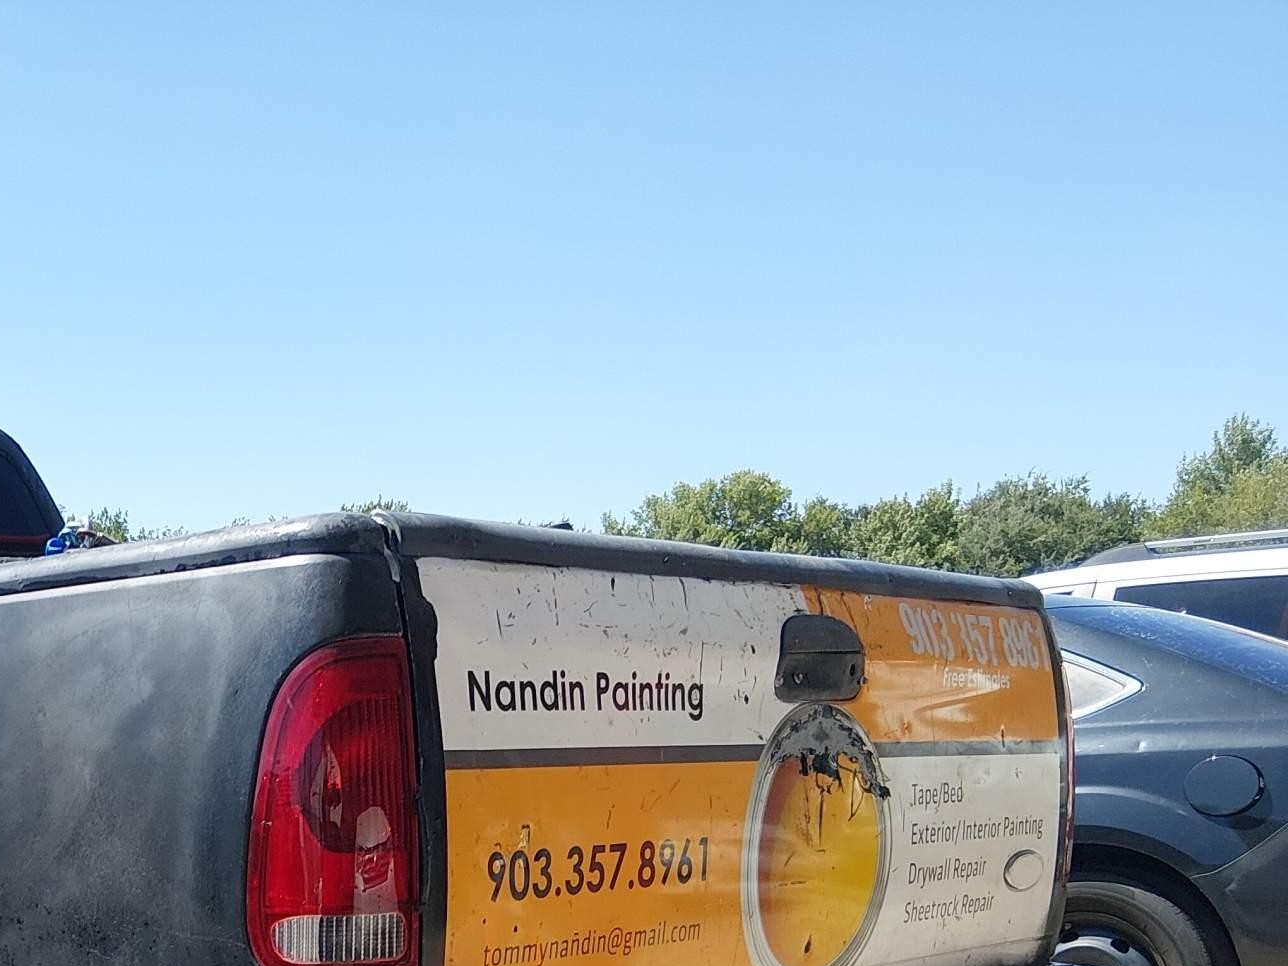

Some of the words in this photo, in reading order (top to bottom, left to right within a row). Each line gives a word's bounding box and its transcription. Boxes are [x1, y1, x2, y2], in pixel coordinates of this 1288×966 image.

[943, 668, 965, 688] Free
[467, 670, 586, 711] Nandin
[595, 671, 704, 721] Painting
[911, 782, 964, 811] Tape/Bed
[1003, 814, 1043, 840] Painting
[487, 837, 709, 902] 903.357.8961
[908, 858, 952, 889] Drywall
[953, 856, 987, 884] Repair
[904, 896, 959, 924] Sheetrock
[961, 891, 995, 918] Repair
